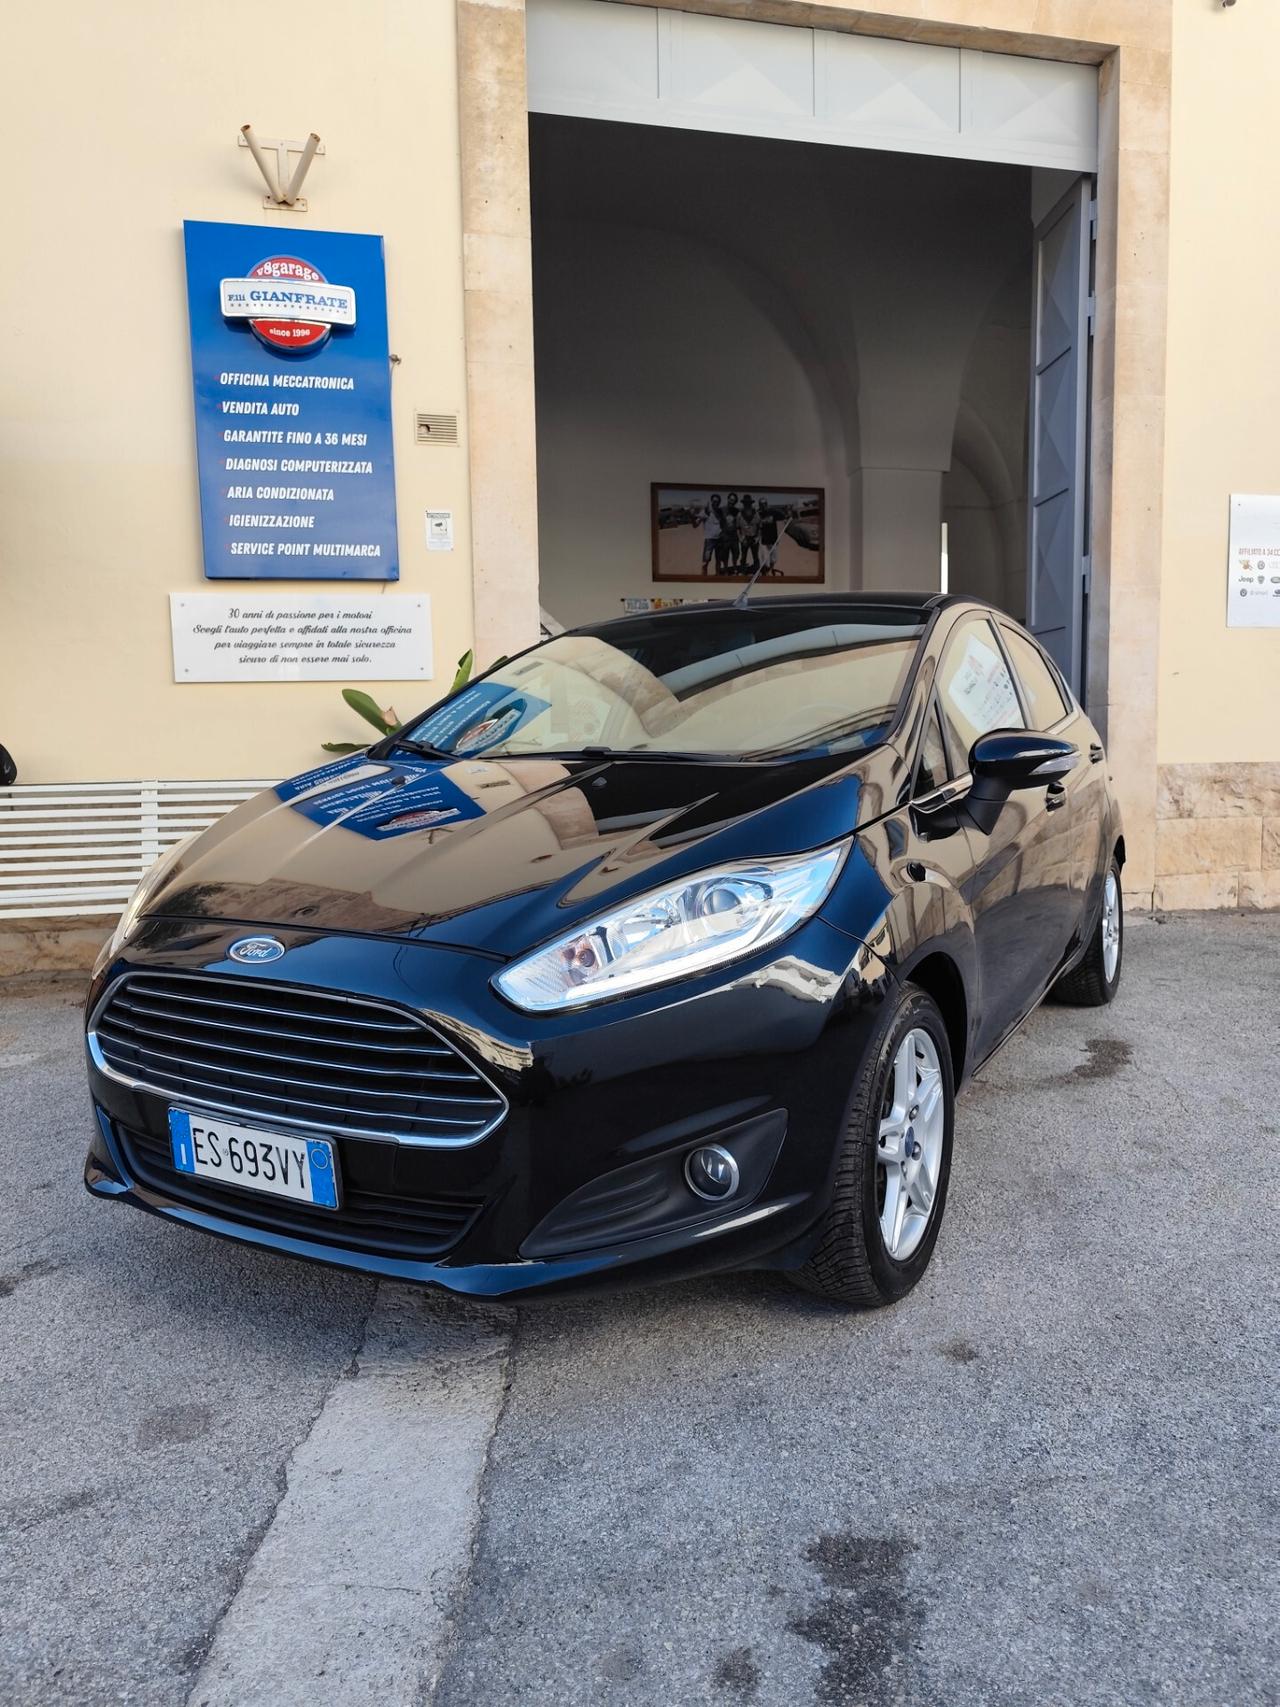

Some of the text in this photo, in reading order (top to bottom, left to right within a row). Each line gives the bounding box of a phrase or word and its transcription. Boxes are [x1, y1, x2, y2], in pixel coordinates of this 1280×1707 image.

[250, 290, 348, 309] GIANFRATE
[269, 328, 290, 337] since
[220, 372, 354, 390] OFFICINA MECCATRONICA
[222, 401, 300, 416] VENDITA AUTO
[223, 430, 368, 446] GARANTITE FINO A 36 MESI
[225, 458, 373, 474] DIAGNOSI COMPUTERIZZATA
[227, 486, 334, 501] ARIA CONDIZIONATA
[229, 514, 315, 528] IGIENIZZAZIONE
[231, 542, 381, 557] SERVICE POINT MULTIMARCA
[242, 610, 264, 619] anni
[265, 610, 274, 619] di
[276, 610, 316, 620] passione
[318, 611, 334, 620] per
[342, 610, 373, 619] motori
[193, 624, 223, 635] Scegli
[250, 625, 286, 635] perfetta
[297, 625, 329, 635] affidati
[330, 625, 348, 634] alla
[350, 626, 378, 634] nostra
[380, 625, 412, 635] officina
[213, 640, 396, 650] per viaggiare sempre in totale sicurezza
[238, 655, 267, 664] sicuro
[269, 655, 278, 663] di
[331, 654, 349, 663] mai
[351, 654, 372, 663] solo.
[239, 941, 273, 958] Ford
